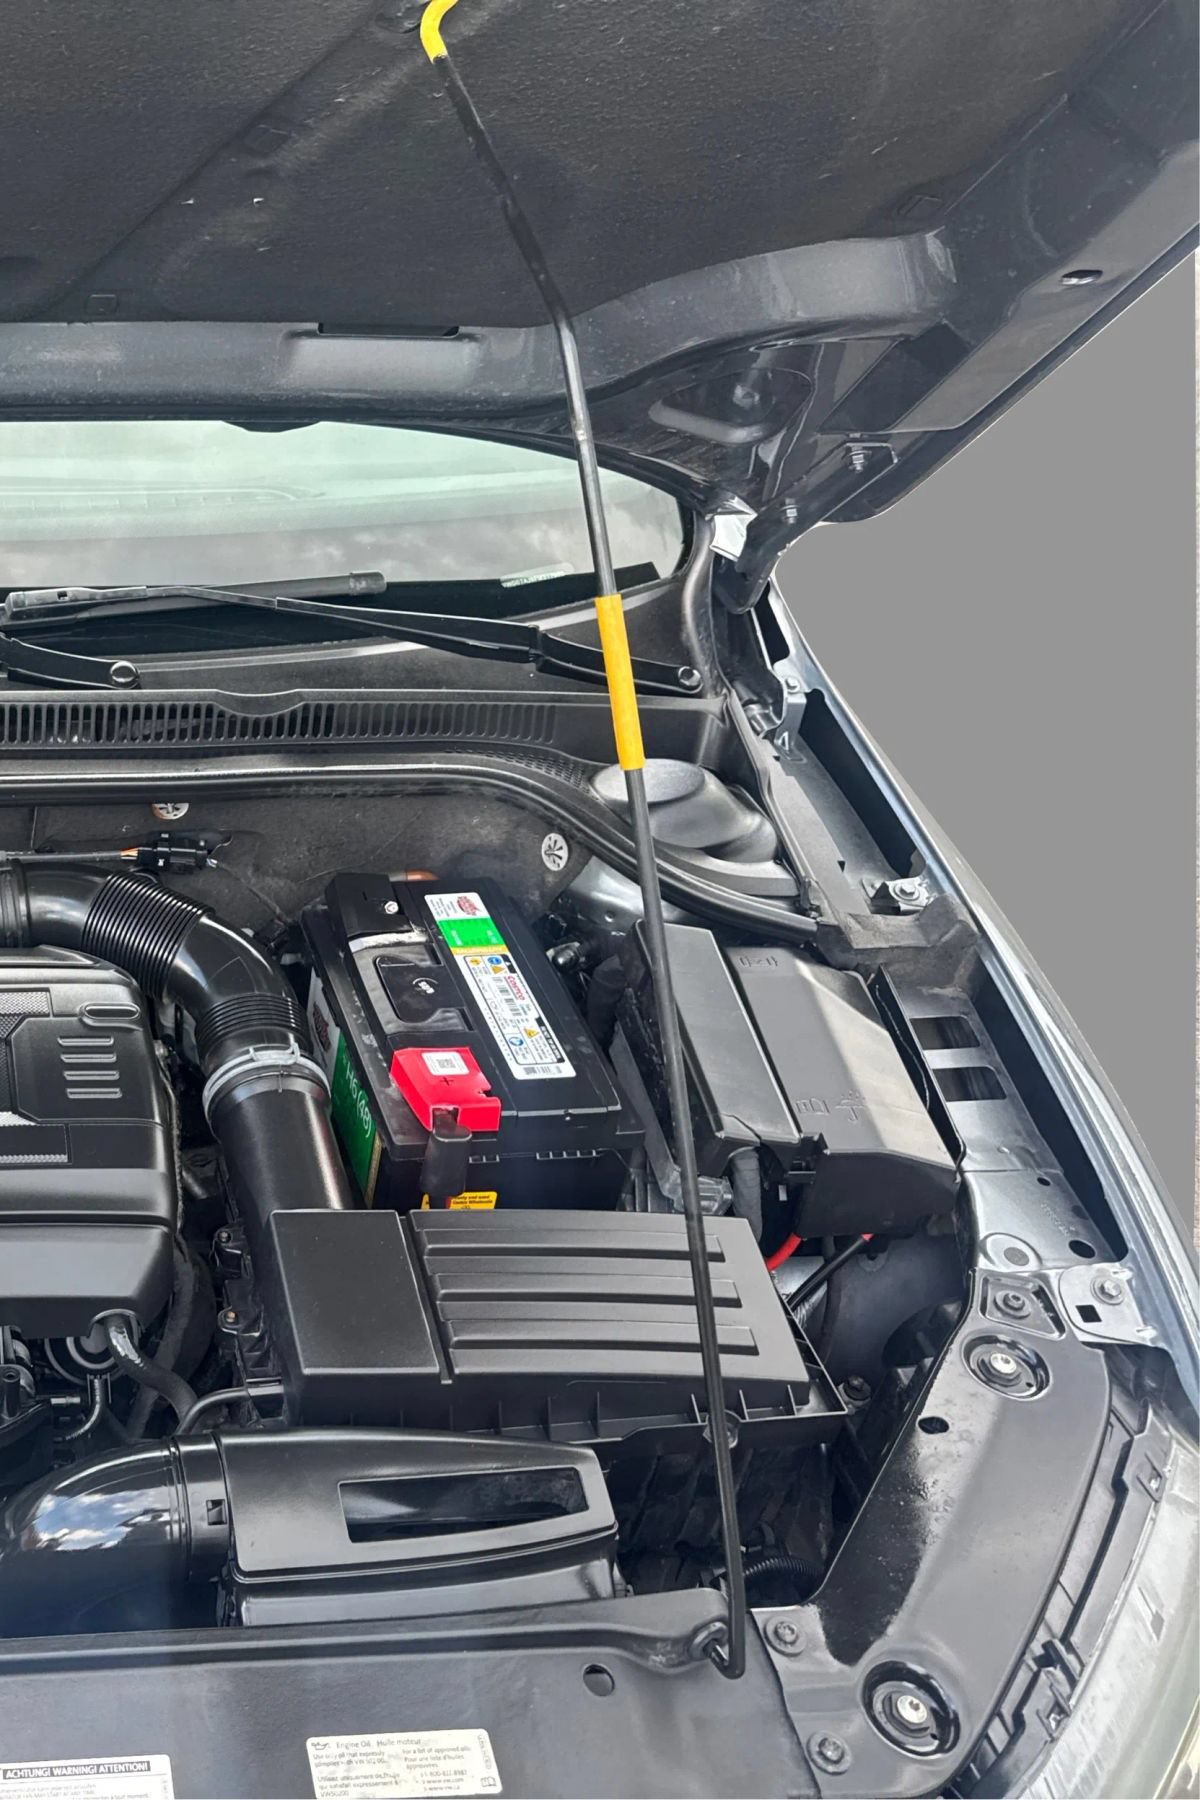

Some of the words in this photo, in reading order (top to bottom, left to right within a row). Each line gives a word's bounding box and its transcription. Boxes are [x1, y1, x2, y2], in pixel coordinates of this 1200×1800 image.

[346, 1061, 358, 1099] H6
[357, 1090, 372, 1138] (48)
[5, 1767, 51, 1779] ACHTUNG!
[52, 1764, 97, 1777] WARNING!
[98, 1761, 148, 1774] ATTENTION!
